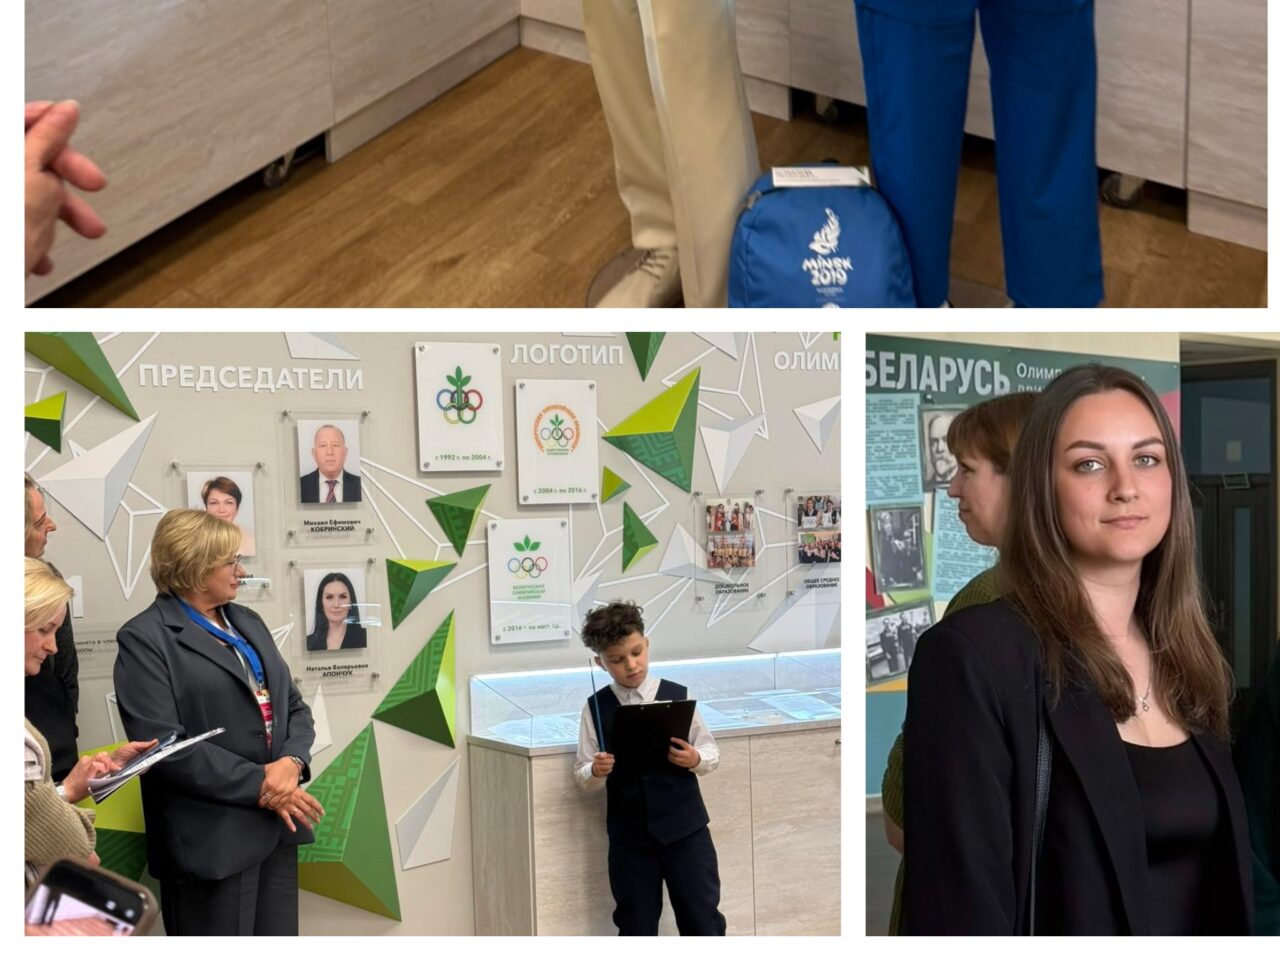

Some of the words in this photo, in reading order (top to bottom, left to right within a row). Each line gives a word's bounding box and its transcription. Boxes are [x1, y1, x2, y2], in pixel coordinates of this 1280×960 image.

[811, 269, 848, 286] 2019
[510, 343, 624, 365] ЛОГОТИП
[138, 362, 365, 393] ПРЕДСЕДАТЕЛИ
[866, 350, 1011, 396] БЕЛАРУСЬ
[310, 525, 355, 533] КОБРИНСКИЙ
[329, 519, 361, 527] Ефимович
[332, 663, 369, 671] Валерьевна
